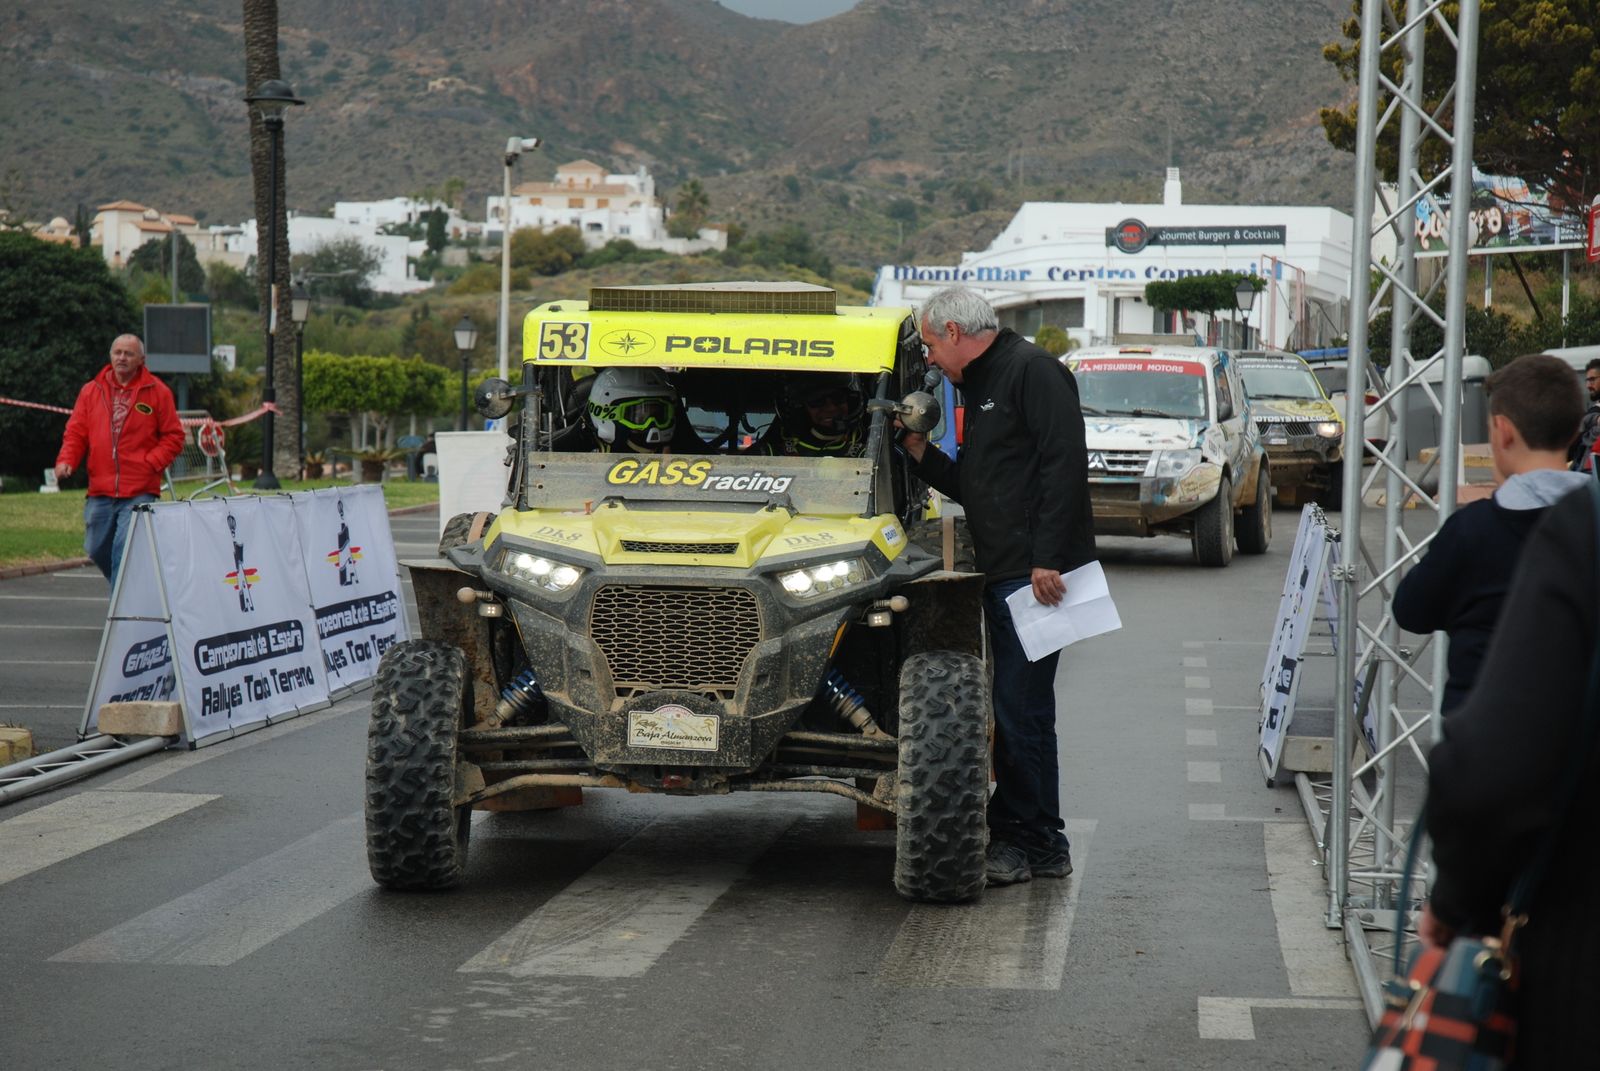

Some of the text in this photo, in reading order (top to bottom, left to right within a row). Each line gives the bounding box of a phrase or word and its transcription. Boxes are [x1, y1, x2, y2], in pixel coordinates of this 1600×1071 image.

[1159, 230, 1196, 241] Gourmet
[1199, 230, 1231, 242] Burgers
[1234, 230, 1241, 240] &
[1243, 229, 1281, 240] Cocktails
[1048, 265, 1136, 280] Centro
[541, 323, 587, 359] 53
[664, 335, 836, 358] POLARIS
[1092, 364, 1184, 373] MITSUBISHI MOTORS
[588, 402, 617, 419] 00%
[607, 460, 792, 495] GASS racing
[202, 681, 243, 719] Rallyes
[634, 728, 660, 741] Baja
